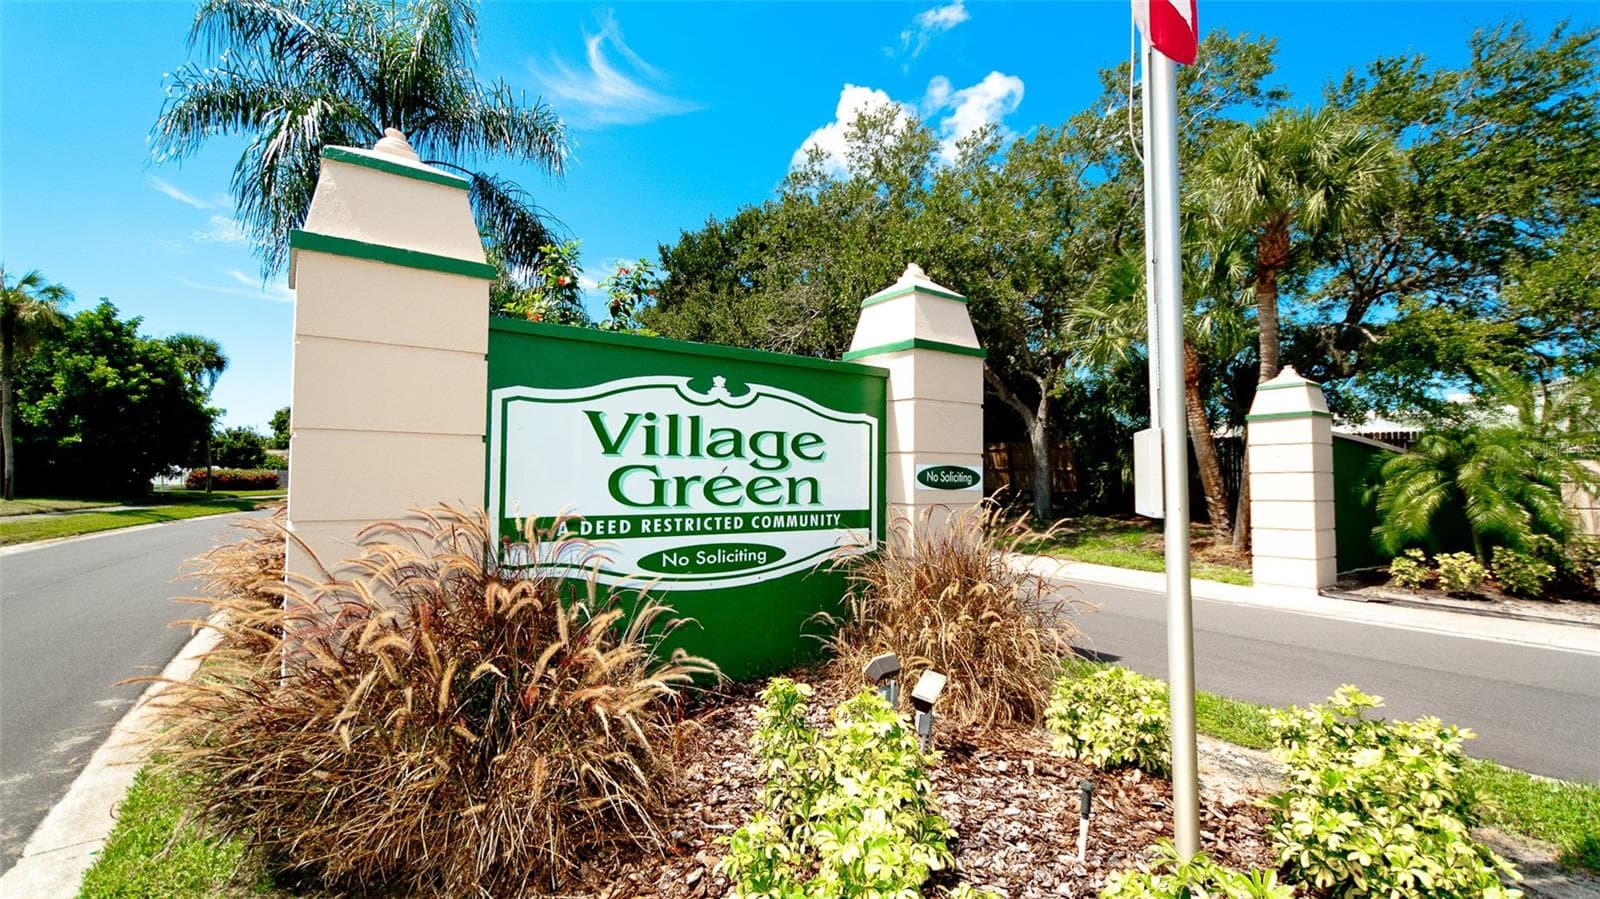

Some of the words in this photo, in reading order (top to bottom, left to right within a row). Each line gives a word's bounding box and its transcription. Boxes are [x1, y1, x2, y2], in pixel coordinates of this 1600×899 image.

[583, 410, 826, 472] Village
[608, 464, 823, 508] Green
[926, 471, 939, 482] No
[940, 470, 973, 485] Soliciting
[556, 521, 569, 536] A
[581, 518, 632, 536] DEED
[641, 516, 744, 534] RESTRICTED
[751, 513, 841, 530] COMMUNITY
[662, 552, 690, 568] No
[696, 547, 767, 564] Soliciting
